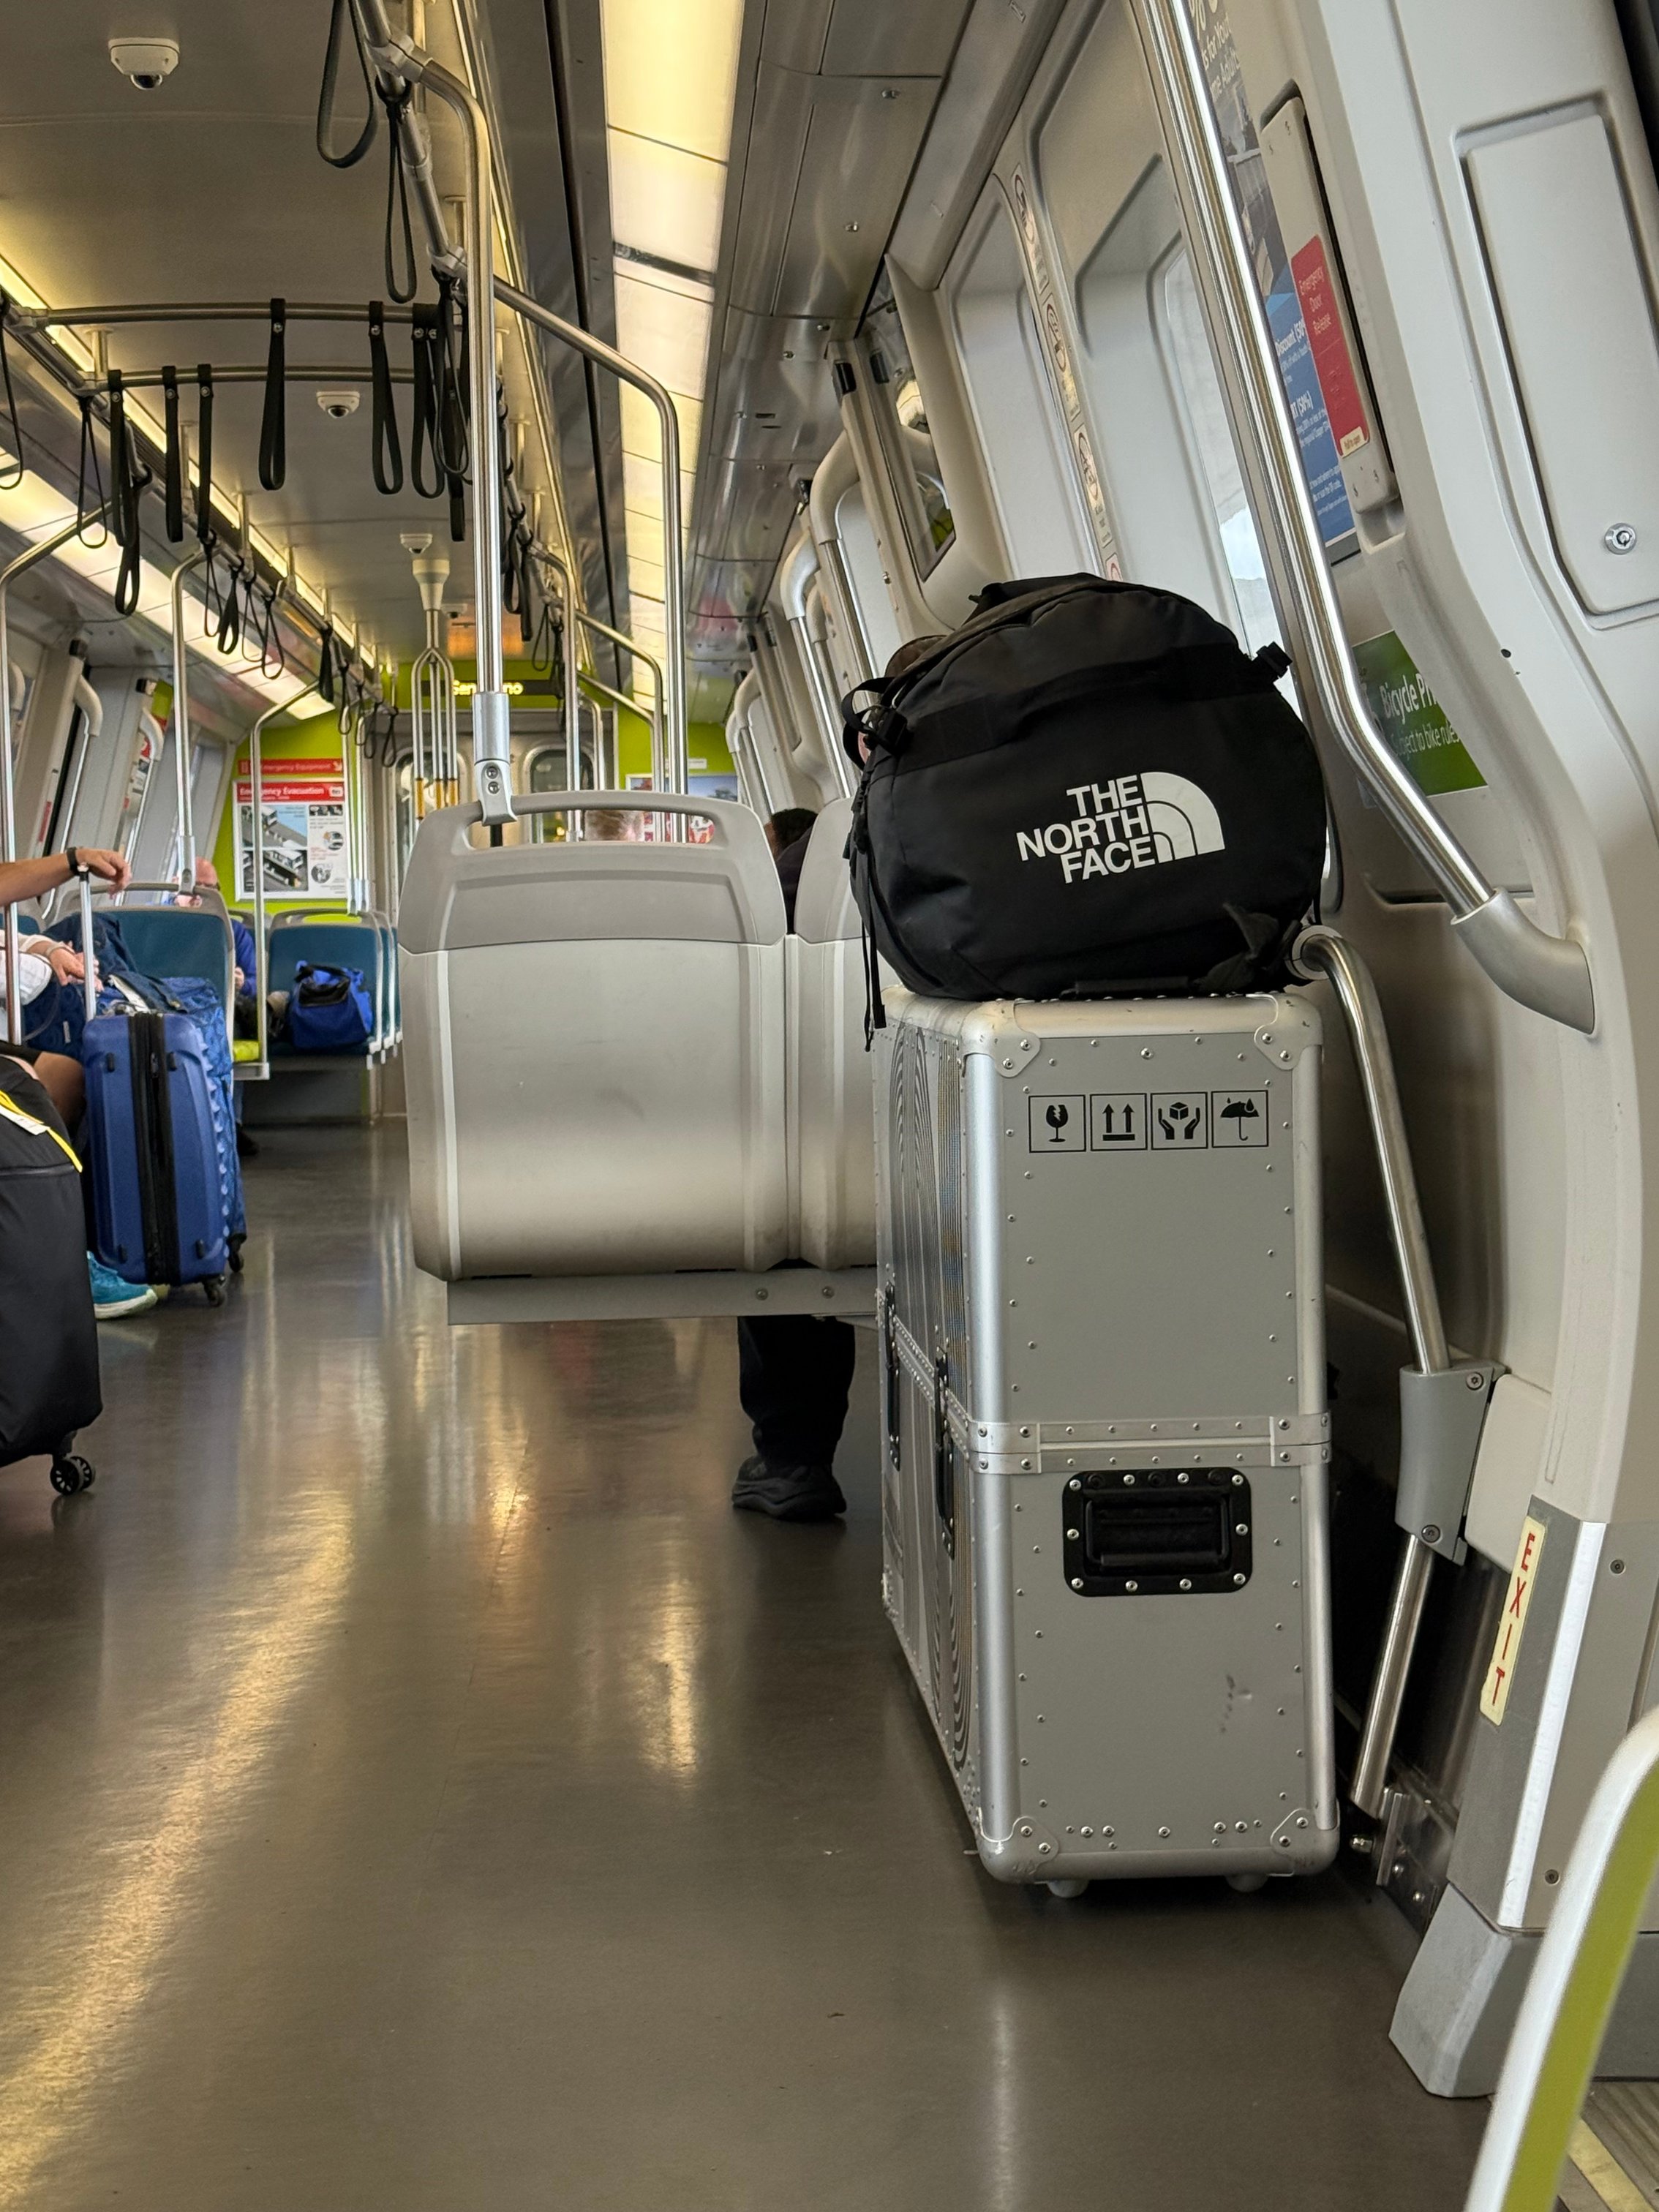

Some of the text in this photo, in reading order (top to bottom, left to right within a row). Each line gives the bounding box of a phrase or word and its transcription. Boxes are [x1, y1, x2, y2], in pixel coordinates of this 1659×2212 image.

[1298, 266, 1325, 296] Emergency
[1309, 294, 1323, 312] Door
[1312, 313, 1332, 335] Release
[1274, 328, 1297, 357] Discount
[1379, 674, 1419, 725] Bicycle
[1415, 730, 1426, 752] to
[1422, 723, 1442, 749] bike
[1066, 775, 1143, 817] THE
[1016, 805, 1149, 862] NORTH
[1060, 836, 1156, 884] FACE
[1491, 1532, 1536, 1707] EXIT
